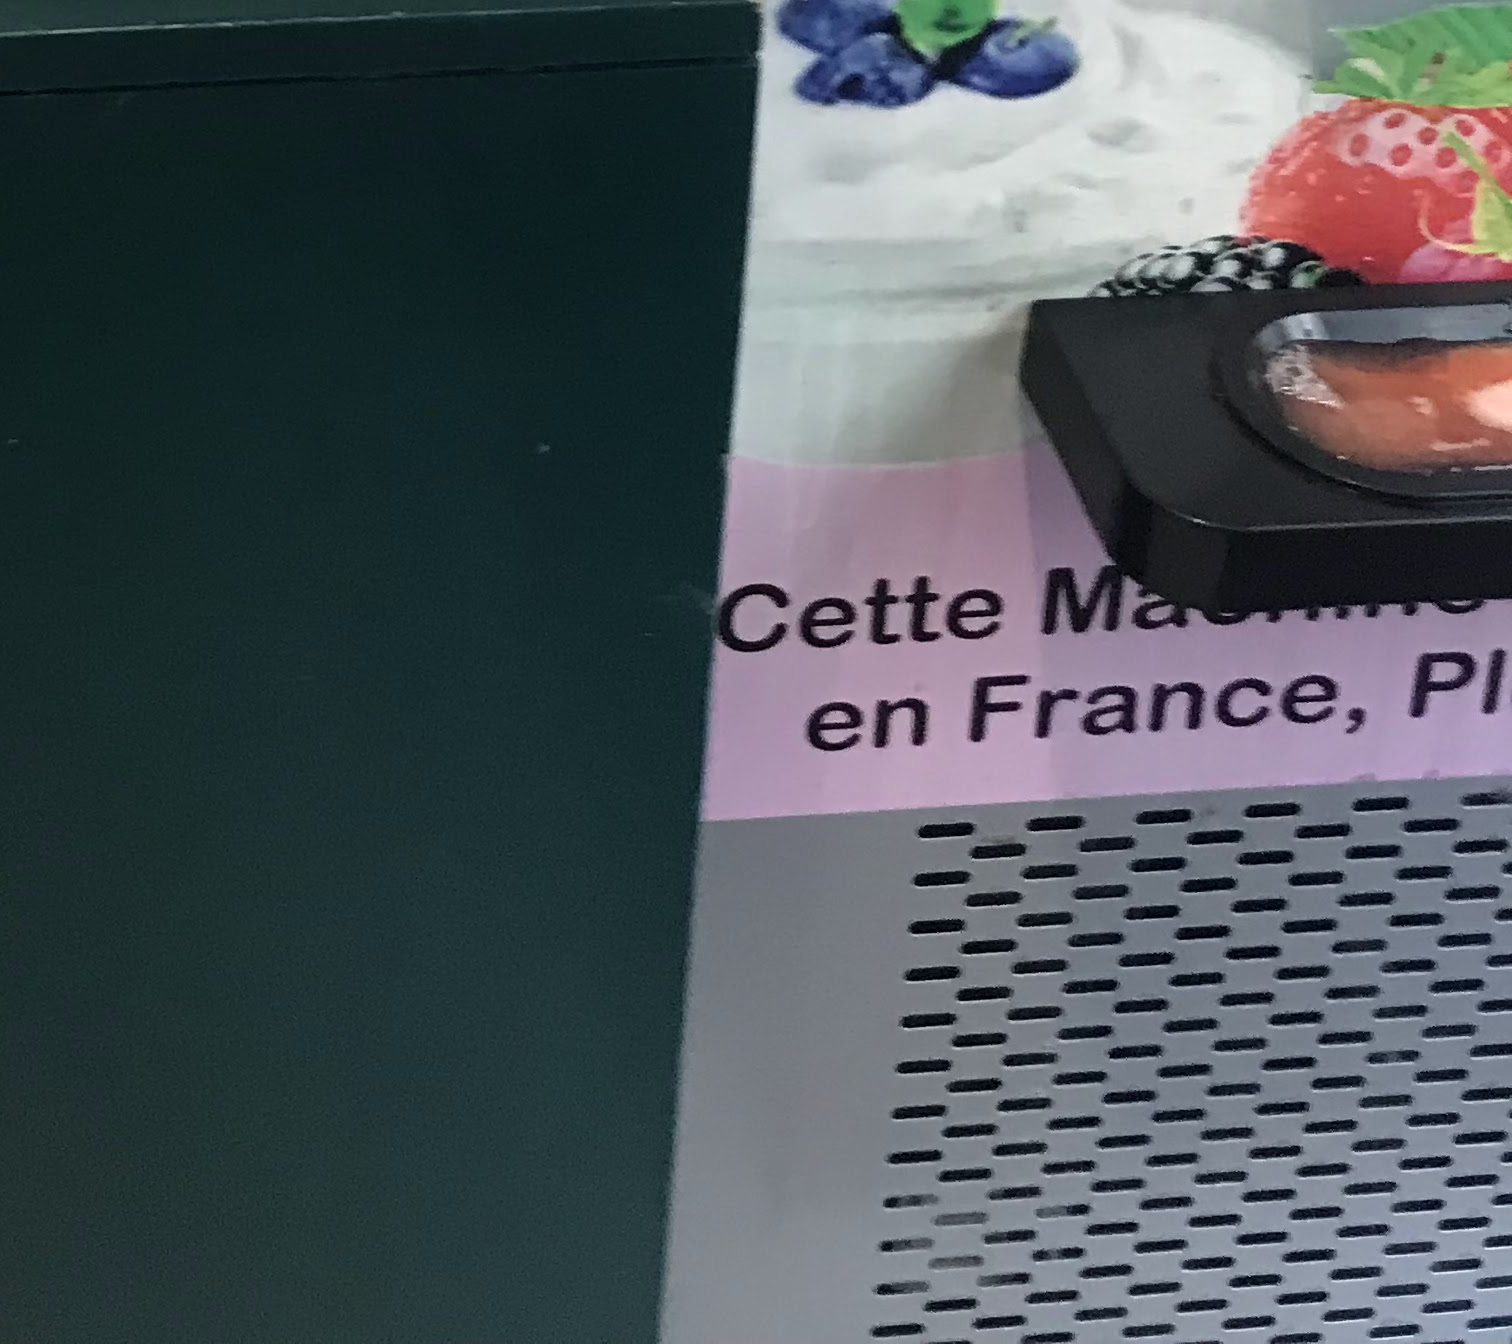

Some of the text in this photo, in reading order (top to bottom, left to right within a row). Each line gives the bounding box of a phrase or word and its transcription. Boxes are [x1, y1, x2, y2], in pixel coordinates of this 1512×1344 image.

[717, 574, 1005, 652] Cette
[805, 695, 929, 751] en
[968, 669, 1367, 743] France,
